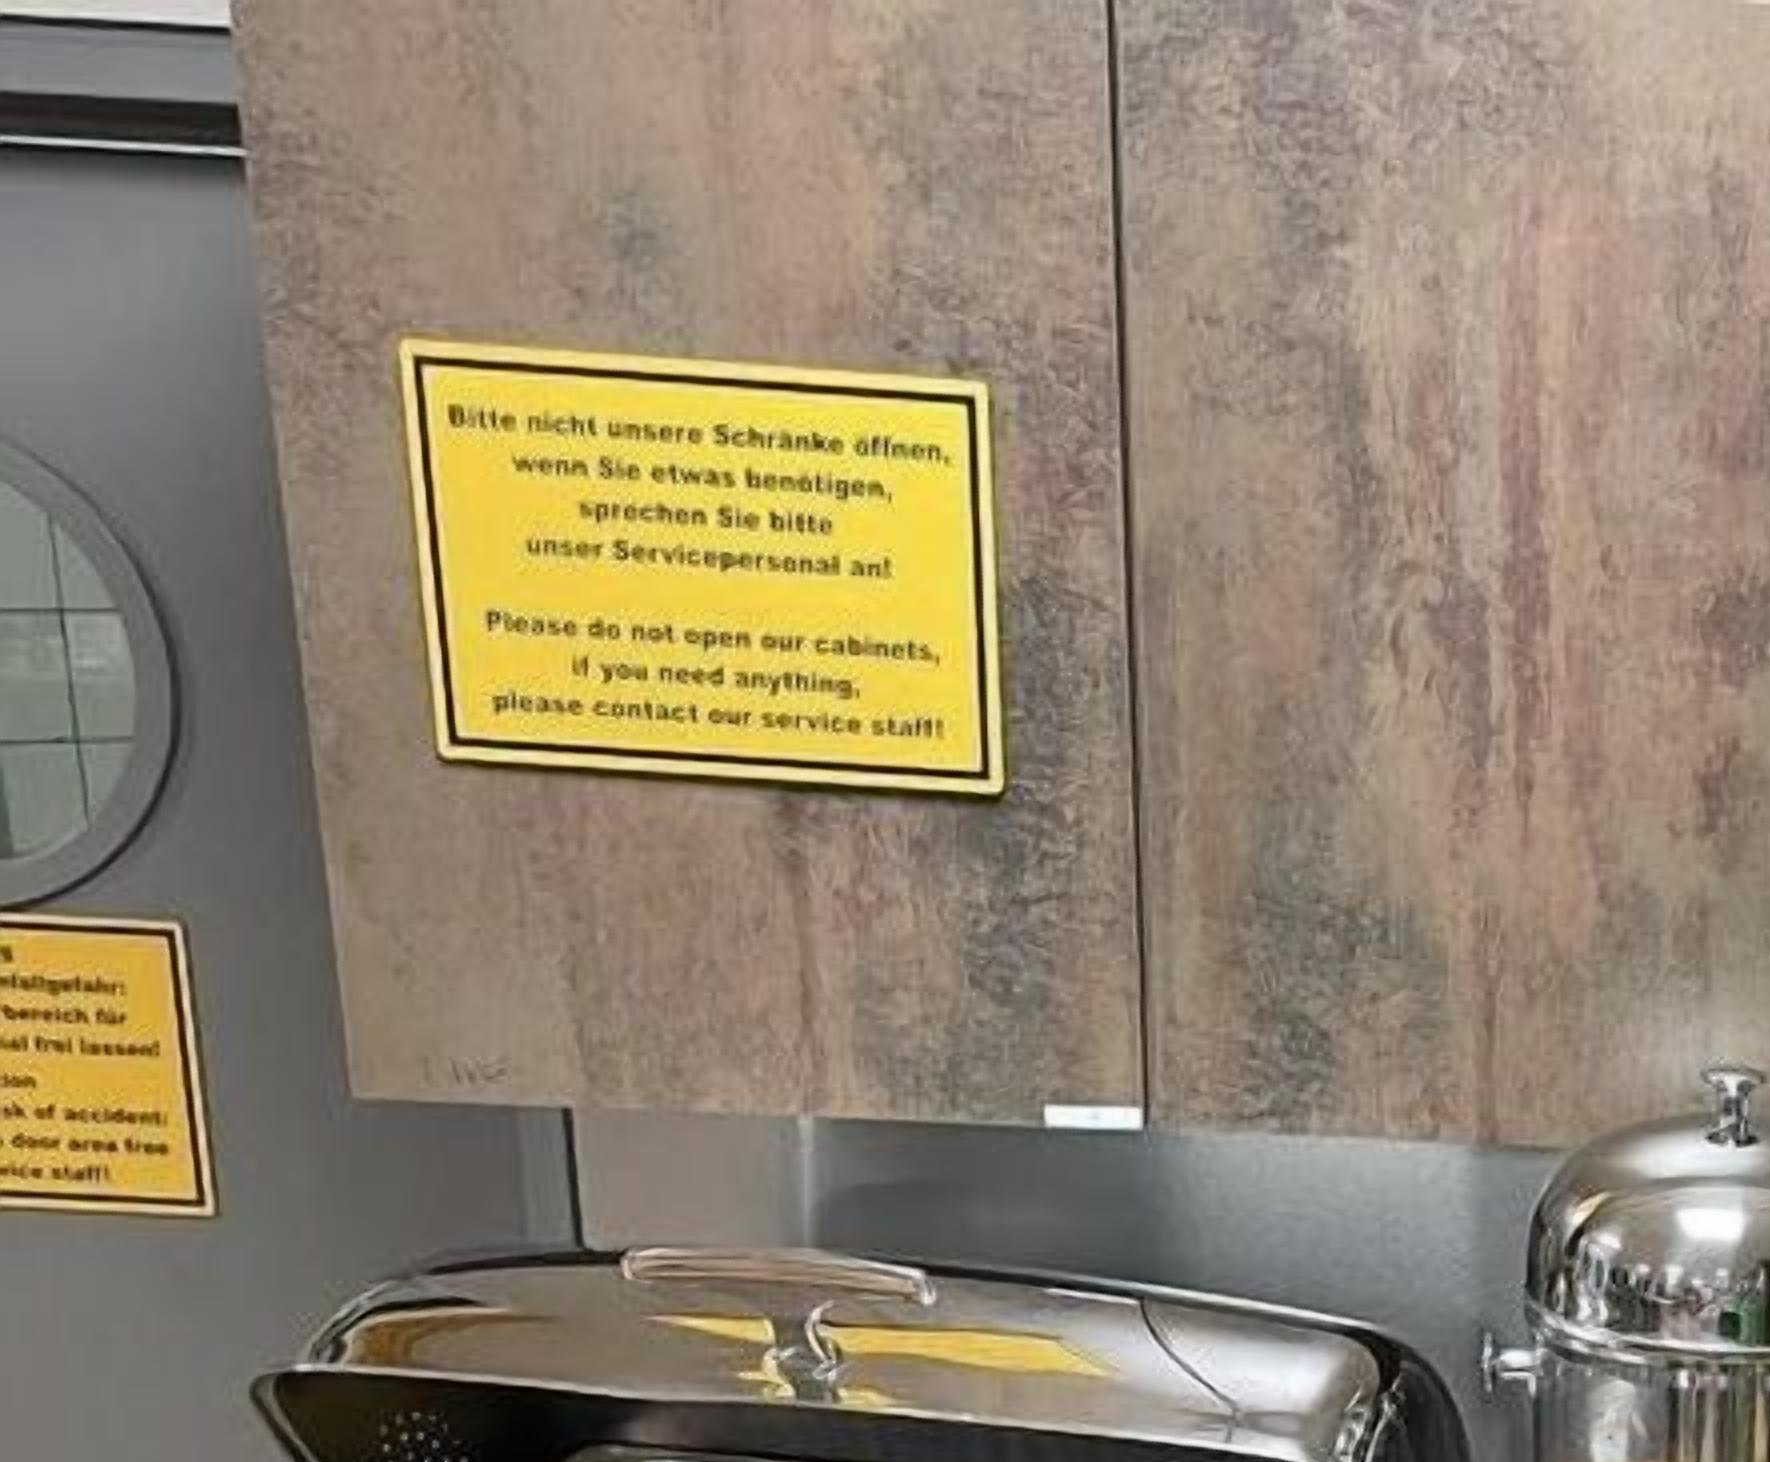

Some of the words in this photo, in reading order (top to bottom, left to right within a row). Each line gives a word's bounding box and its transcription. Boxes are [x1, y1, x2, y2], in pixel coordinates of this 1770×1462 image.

[448, 405, 517, 431] Bitte
[527, 412, 598, 436] nicht
[608, 421, 703, 443] unsere
[512, 457, 588, 476] wenn
[600, 456, 640, 480] Sie
[651, 464, 735, 488] etwas
[579, 502, 708, 526] sprechen
[717, 505, 760, 530] Sie
[769, 509, 832, 534] bitte
[527, 538, 603, 557] unser
[612, 539, 841, 576] Servicepersonal
[487, 609, 577, 638] Please
[588, 617, 620, 640] do
[632, 622, 673, 644] not
[684, 629, 750, 652] open
[760, 634, 805, 652] our
[816, 635, 940, 666] cabinets,
[572, 653, 588, 677] if
[600, 662, 648, 684] you
[659, 665, 724, 686] need
[492, 691, 583, 716] please
[593, 698, 697, 723] contact
[708, 707, 751, 726] our
[761, 711, 861, 734] service
[34, 1104, 56, 1120] of
[69, 1137, 118, 1153] area
[124, 1137, 169, 1156] free
